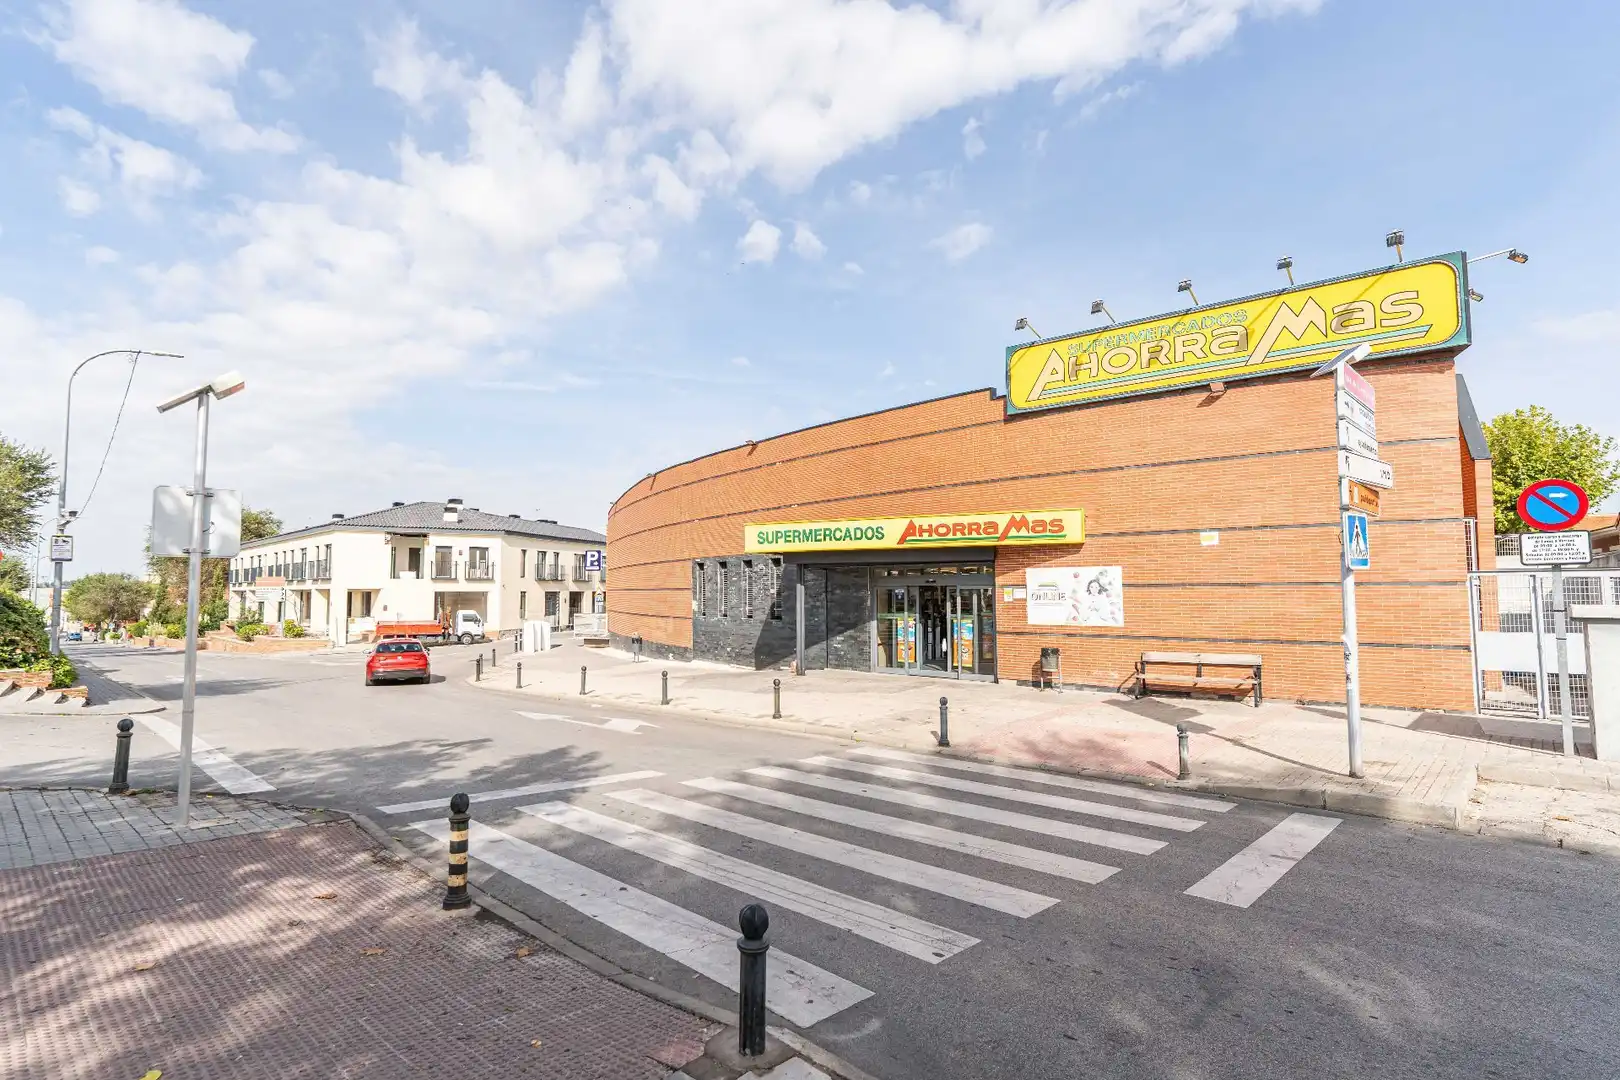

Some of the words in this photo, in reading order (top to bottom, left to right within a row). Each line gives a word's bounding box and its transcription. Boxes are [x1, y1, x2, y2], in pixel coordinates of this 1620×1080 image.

[1066, 308, 1249, 357] SUPERMERCADOS
[757, 526, 886, 545] SUPERMERCADOS
[586, 551, 599, 567] P
